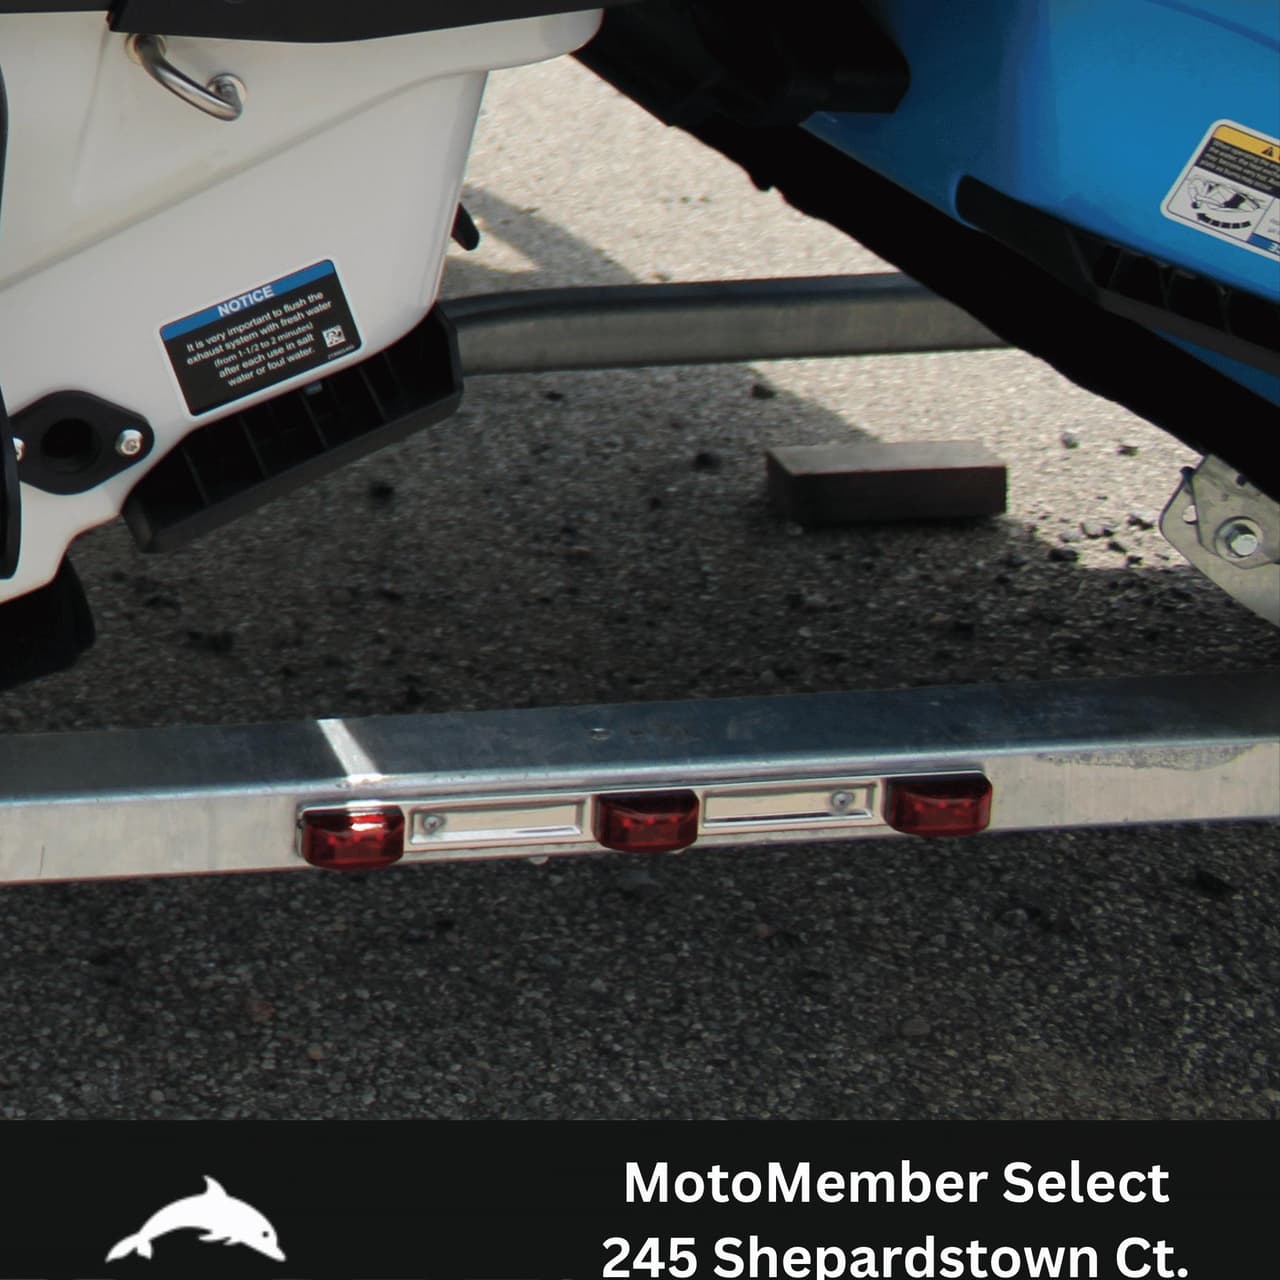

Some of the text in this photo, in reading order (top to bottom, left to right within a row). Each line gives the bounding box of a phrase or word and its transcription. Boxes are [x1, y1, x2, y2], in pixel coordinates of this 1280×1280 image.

[187, 344, 194, 352] It
[206, 332, 225, 344] very
[227, 312, 271, 336] important
[272, 309, 282, 317] to
[283, 299, 306, 312] flush
[308, 292, 323, 303] the
[218, 286, 274, 316] NOTICE
[187, 301, 331, 364] exhaust system with fresh water
[214, 354, 237, 367] (from
[238, 344, 259, 357] 1-1/2
[277, 322, 313, 341] minutes)
[220, 364, 239, 377] after
[242, 354, 265, 368] each
[267, 347, 284, 358] use
[297, 334, 314, 346] salt
[228, 371, 253, 386] water
[256, 367, 265, 375] or
[267, 357, 285, 370] foul
[287, 347, 314, 362] water.
